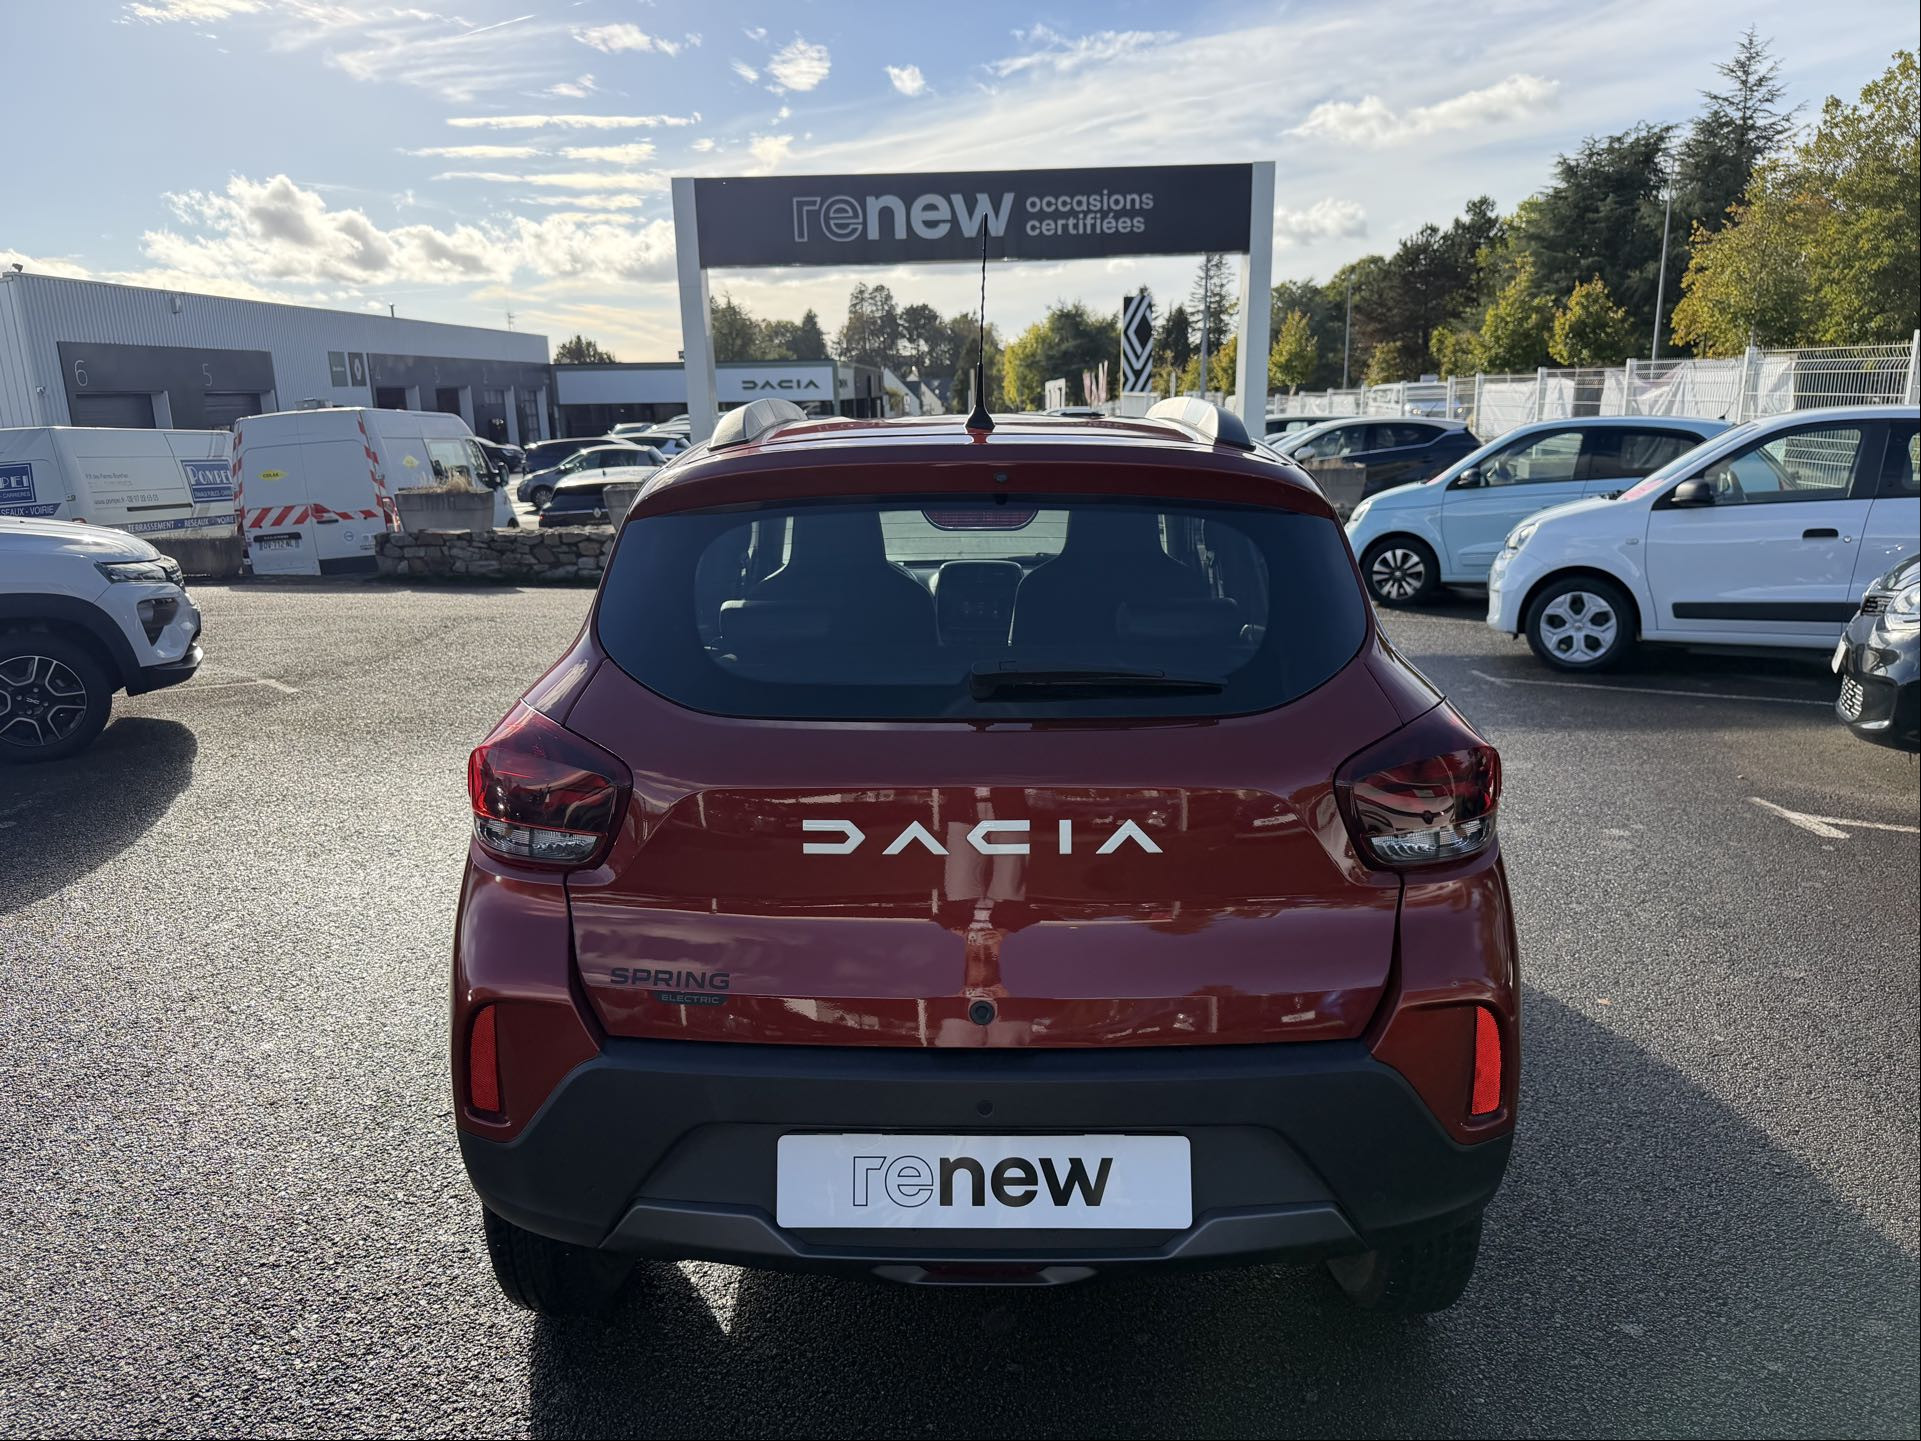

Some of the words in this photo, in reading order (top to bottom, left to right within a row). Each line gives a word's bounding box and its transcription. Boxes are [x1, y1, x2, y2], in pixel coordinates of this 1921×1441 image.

[1025, 189, 1155, 213] occasions
[793, 192, 1015, 243] renew
[1025, 213, 1146, 236] certifiées
[74, 359, 88, 387] 6
[202, 363, 213, 386] 5
[741, 379, 820, 390] DACIA
[29, 505, 55, 515] VOIRIE
[127, 520, 175, 532] TERRASSEMENT
[802, 819, 1164, 855] DACIA
[610, 967, 730, 990] SPRING
[661, 994, 720, 1004] ELECTRIC
[852, 1155, 1113, 1208] renew
